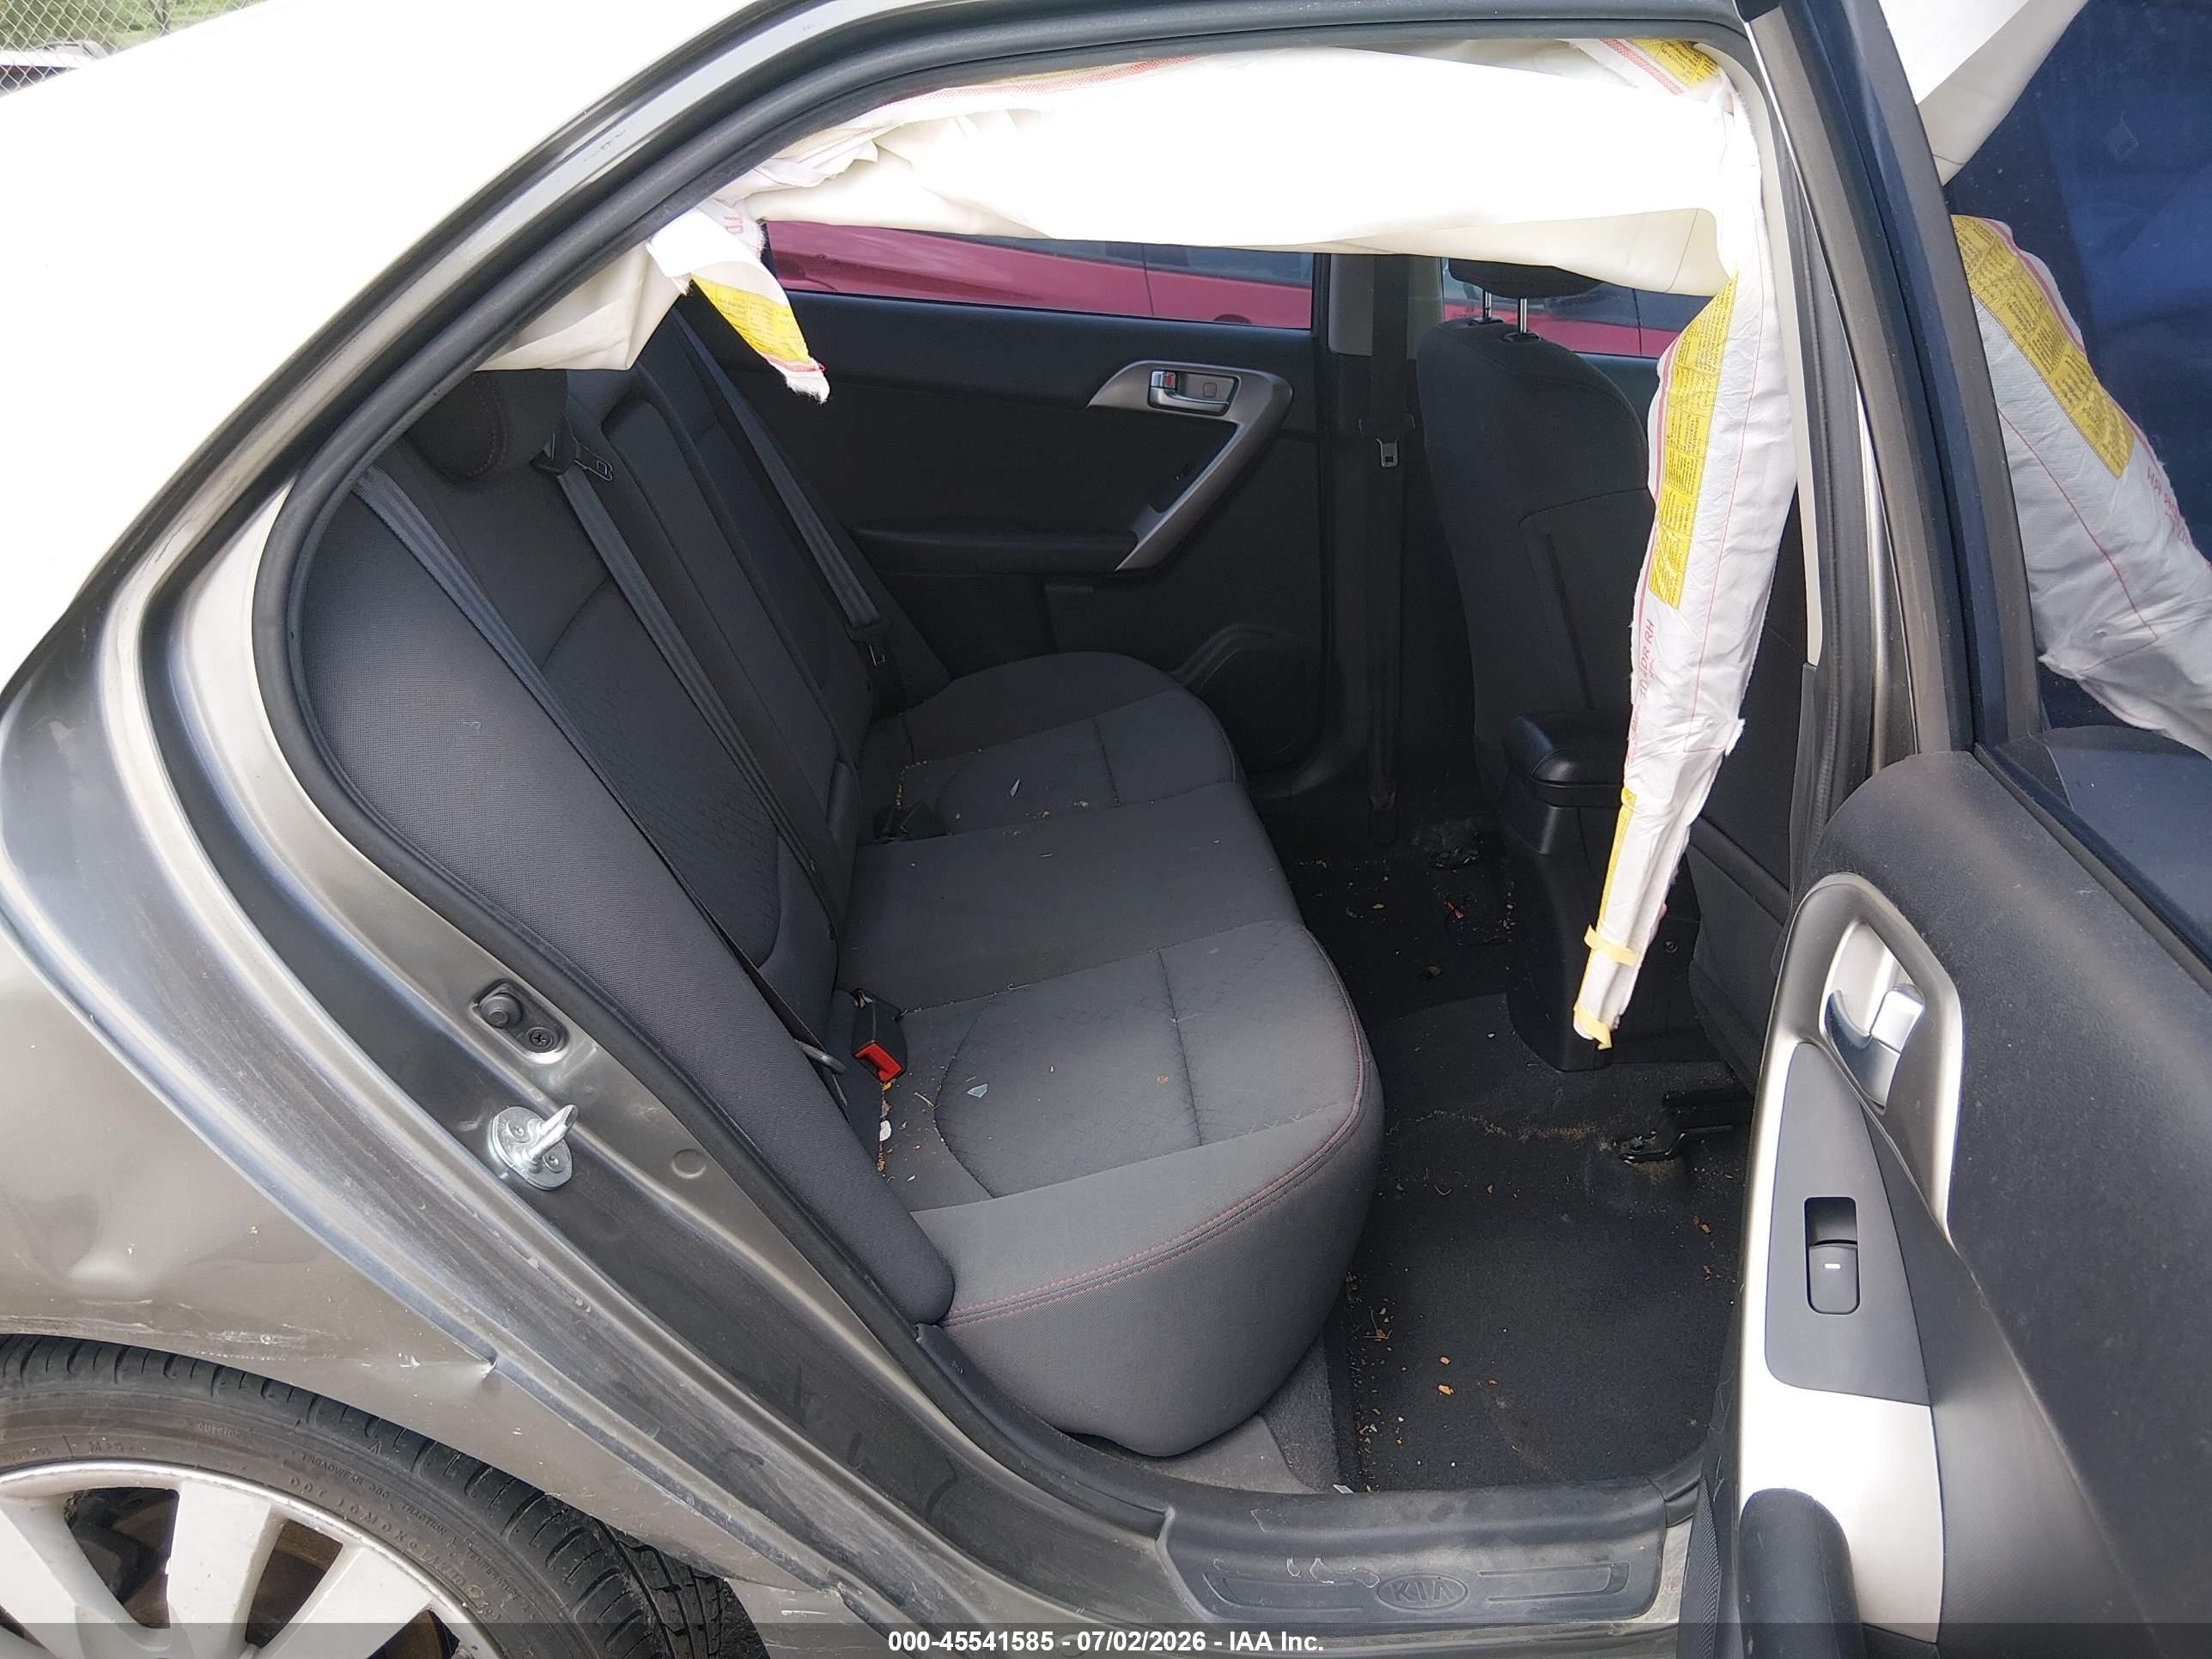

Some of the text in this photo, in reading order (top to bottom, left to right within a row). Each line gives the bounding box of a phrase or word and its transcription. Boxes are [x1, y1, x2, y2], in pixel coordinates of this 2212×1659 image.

[1644, 617, 1655, 645] RH
[400, 1502, 447, 1534] TRACTION
[1389, 1580, 1455, 1603] KIA
